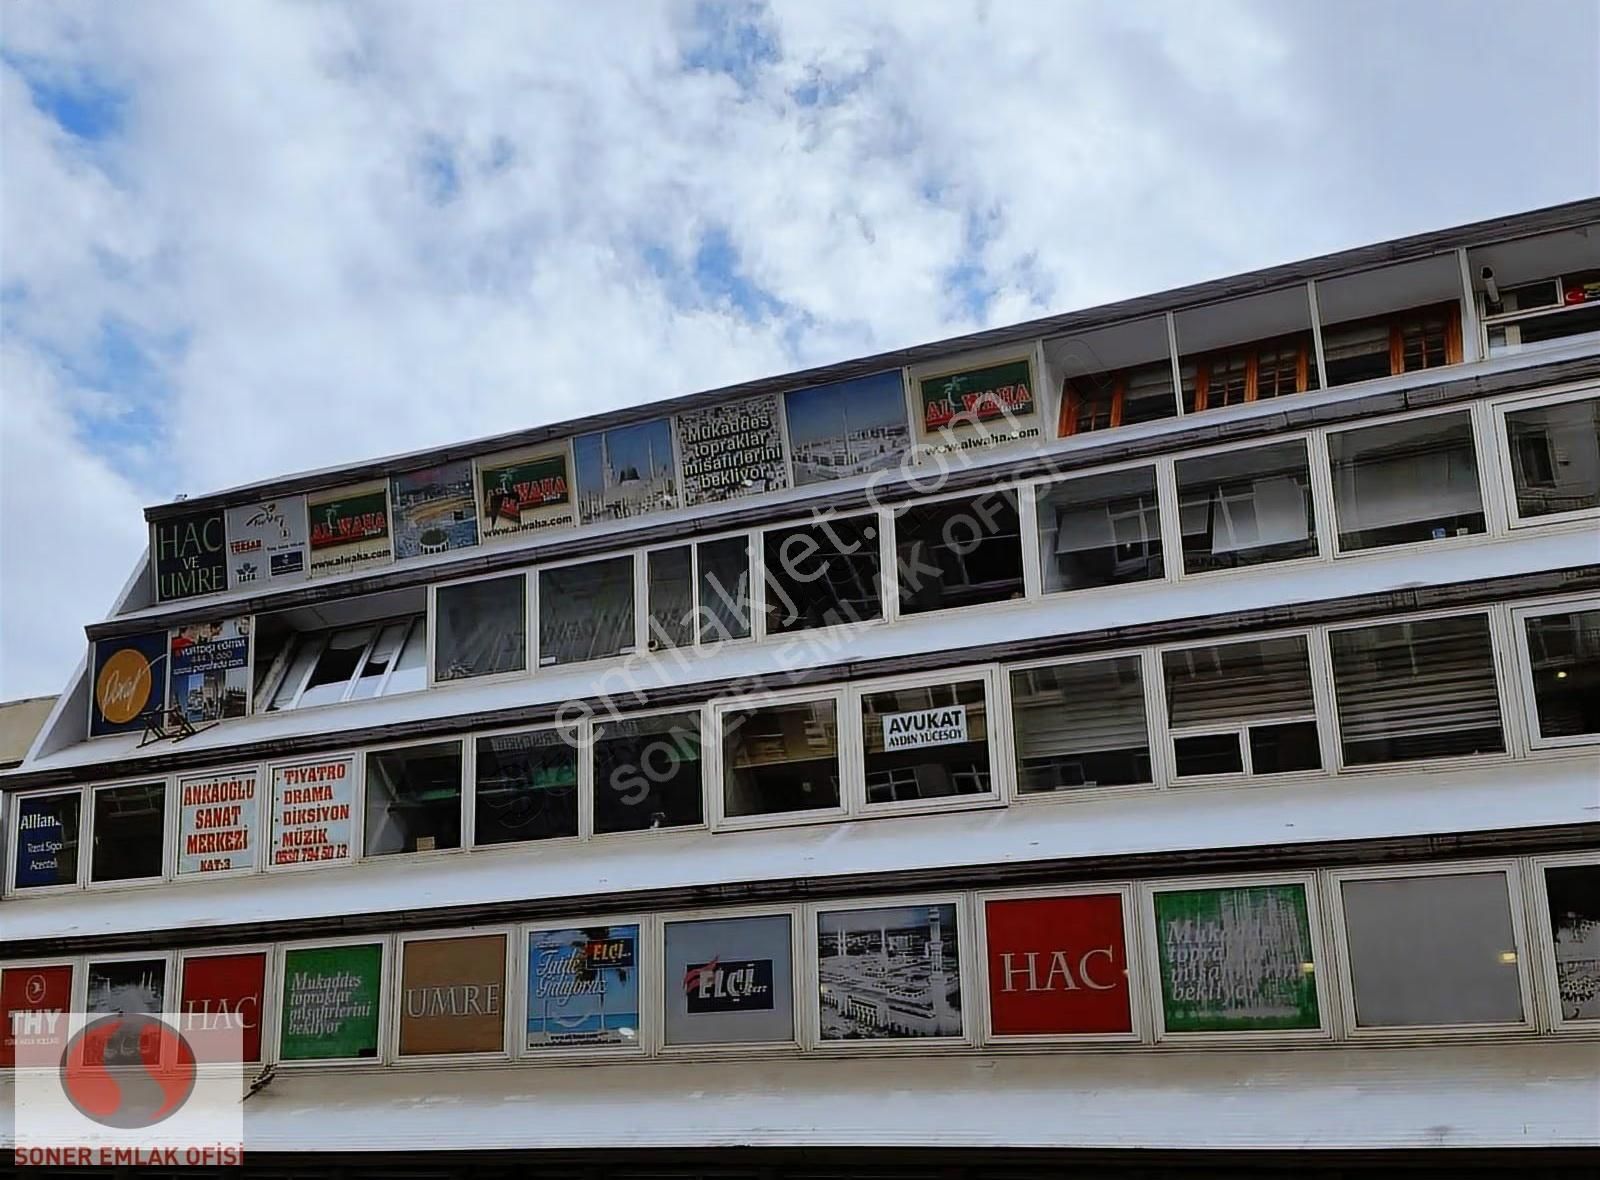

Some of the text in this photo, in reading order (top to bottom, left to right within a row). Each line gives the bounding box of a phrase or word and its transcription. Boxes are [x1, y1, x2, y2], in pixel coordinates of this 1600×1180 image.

[962, 384, 1032, 412] WAHA
[687, 415, 770, 442] Mukaddes
[694, 432, 767, 458] topraklar
[684, 445, 781, 476] misafirlerini
[700, 466, 765, 489] bekliyor
[160, 517, 223, 561] HAC
[483, 515, 572, 538] www.alwaha.com
[182, 556, 200, 571] VE
[161, 565, 225, 599] UMRE
[889, 710, 962, 734] AVUKAT
[889, 734, 918, 747] AYDIN
[284, 785, 334, 805] DRAMA
[195, 805, 241, 830] SANAT
[283, 803, 349, 826] DİKSİYON
[186, 824, 248, 855] MERKEZİ
[282, 826, 328, 847] MÜZİK
[290, 970, 362, 991] Mukaddes
[999, 944, 1117, 992] HAC
[185, 992, 258, 1031] HAC
[405, 984, 500, 1018] UMRE
[8, 1008, 62, 1036] THY
